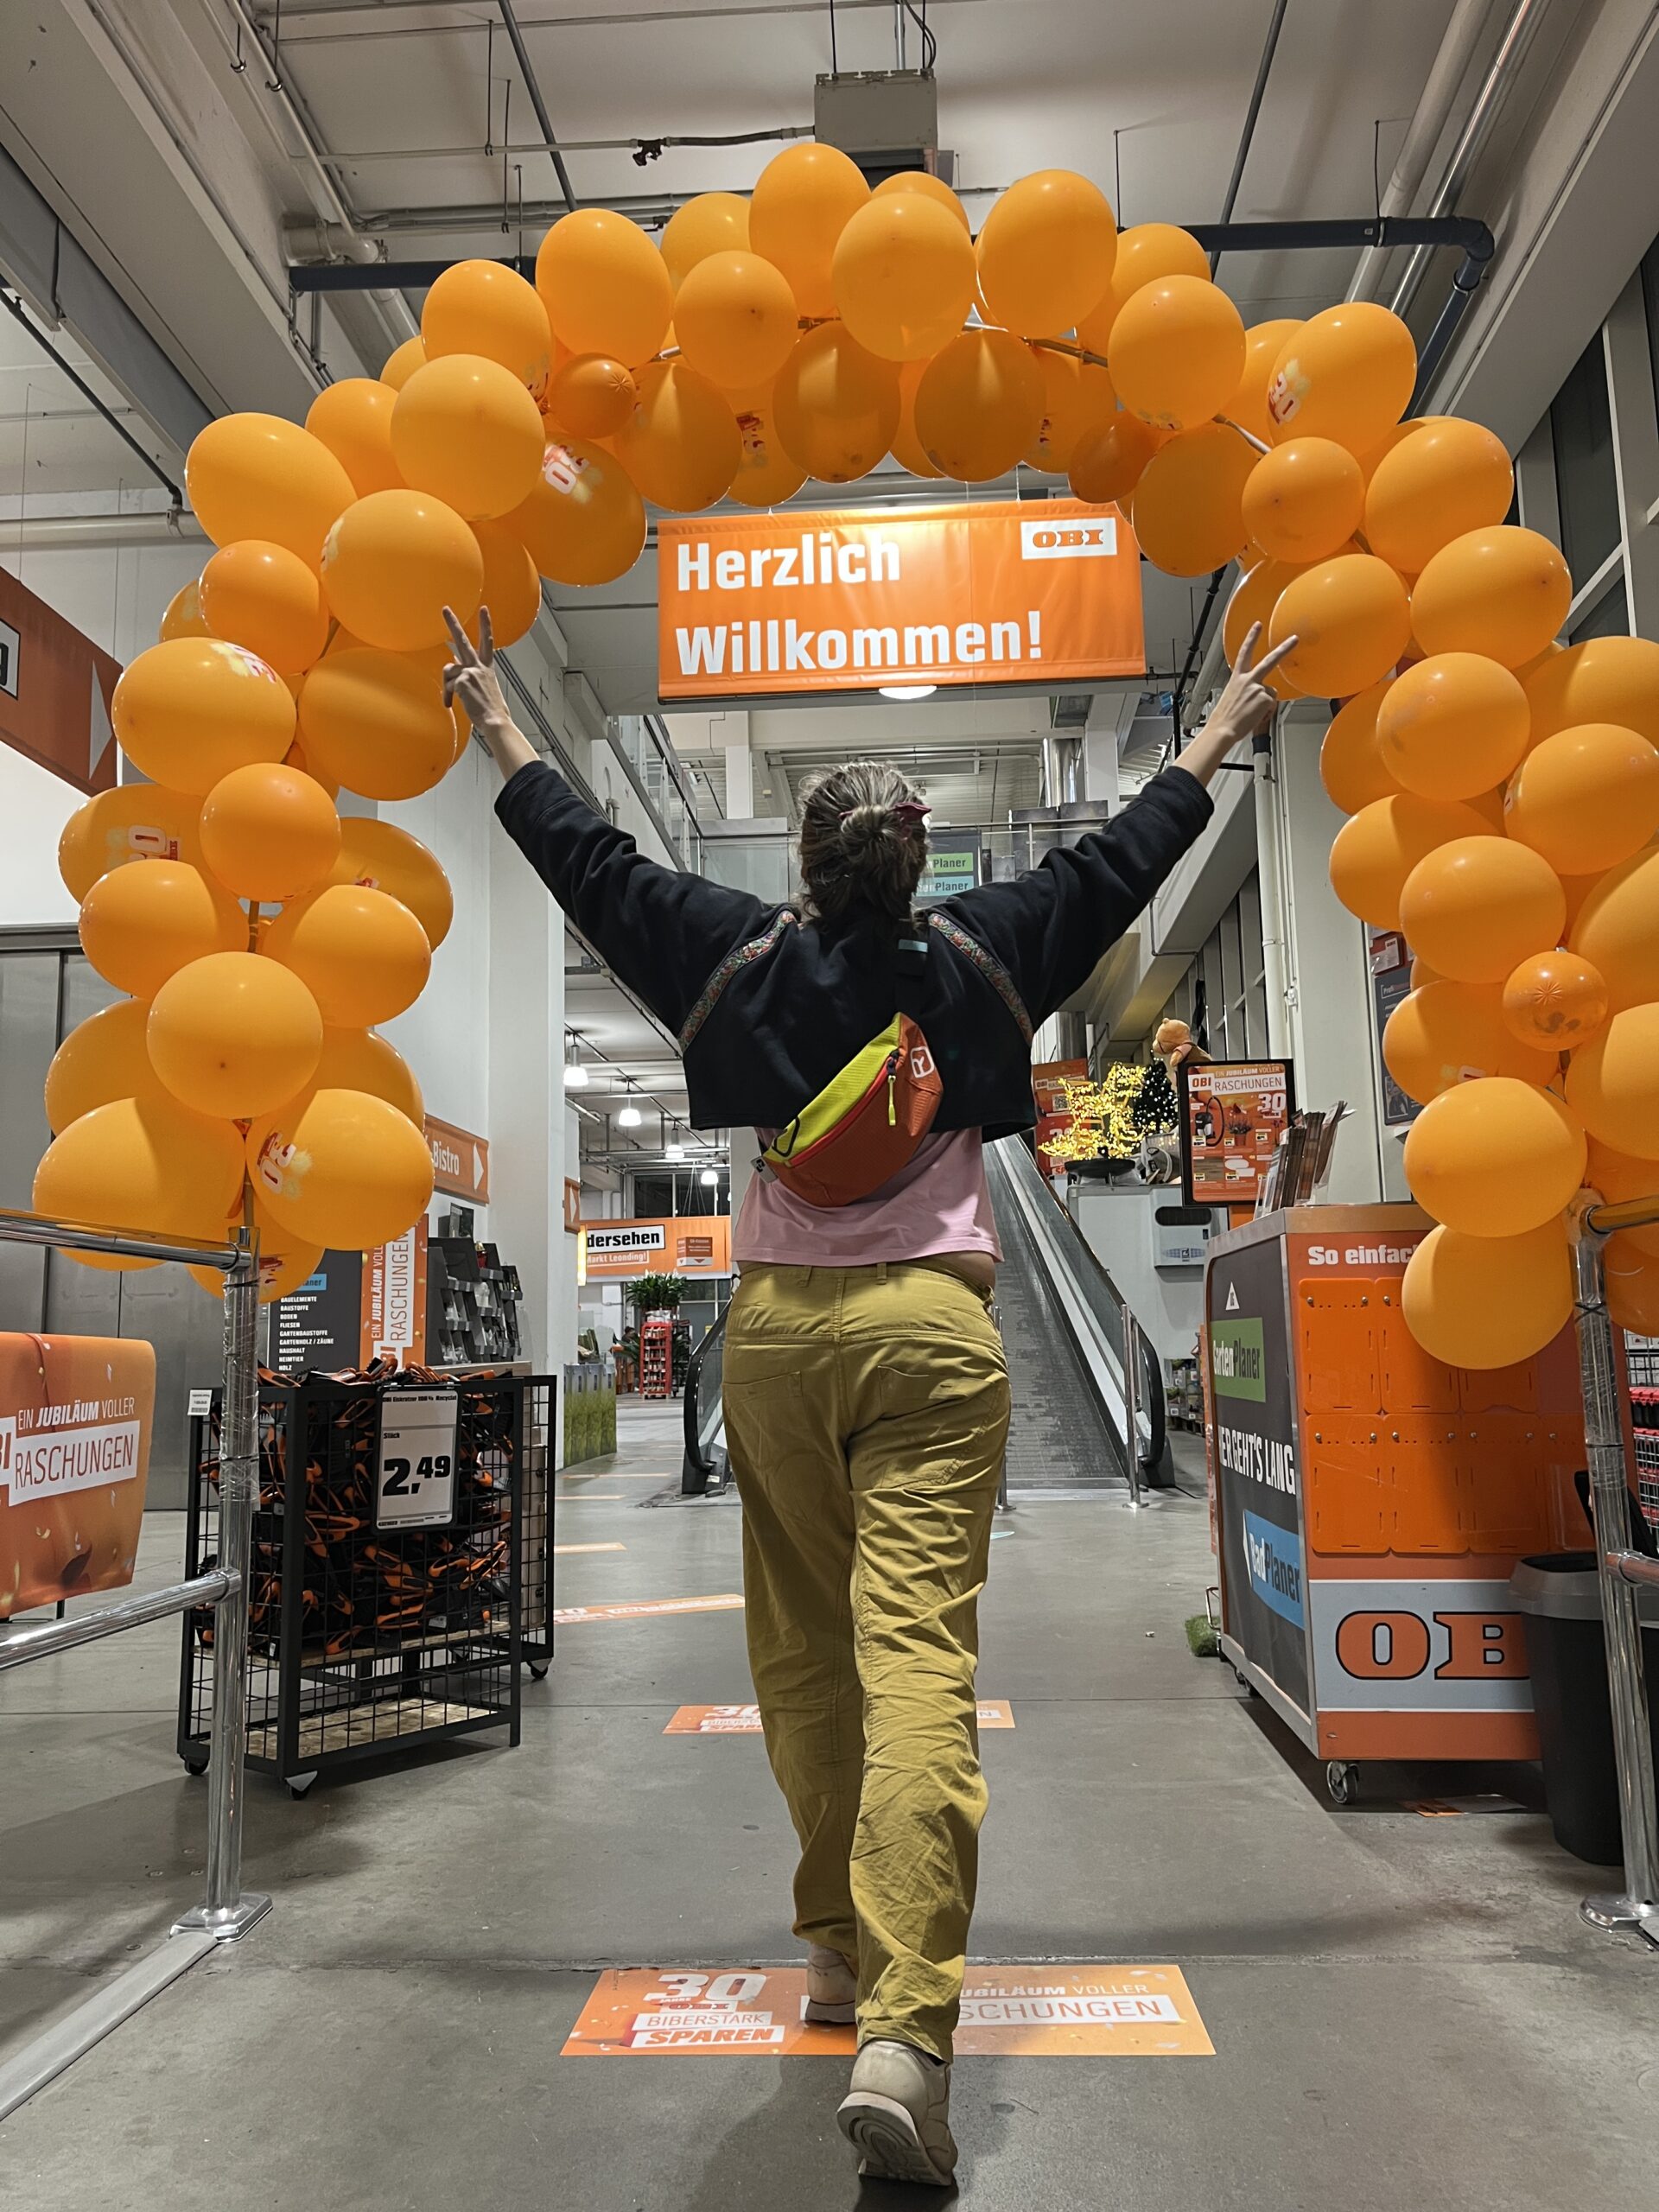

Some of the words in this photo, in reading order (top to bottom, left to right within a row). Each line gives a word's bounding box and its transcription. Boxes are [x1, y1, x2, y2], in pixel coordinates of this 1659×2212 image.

[1033, 528, 1104, 548] OBI
[677, 531, 900, 591] Herzlich
[676, 610, 1042, 676] Willkommen!
[1192, 1077, 1211, 1087] OBI
[1214, 1077, 1282, 1091] RASCHUNGEN
[1257, 1092, 1286, 1112] 30
[433, 1140, 460, 1176] Bistro
[609, 1252, 646, 1262] Leonding!
[1307, 1246, 1339, 1265] So
[1345, 1244, 1417, 1265] einfac
[371, 1268, 383, 1321] JUBILÄUM
[372, 1325, 382, 1338] EIN
[18, 1409, 34, 1431] EIN
[35, 1400, 99, 1428] JUBILÄUM
[101, 1397, 135, 1419] VOLLER
[16, 1434, 134, 1490] RASCHUNGEN
[1231, 1429, 1263, 1483] GEHT'S
[1265, 1439, 1296, 1495] LANG
[643, 1974, 767, 2001] 30
[1072, 1984, 1150, 1995] VOLLER
[647, 2014, 765, 2026] BIBERSTARK
[959, 2000, 1162, 2020] SCHUNGEN
[645, 2028, 775, 2045] SPAREN
